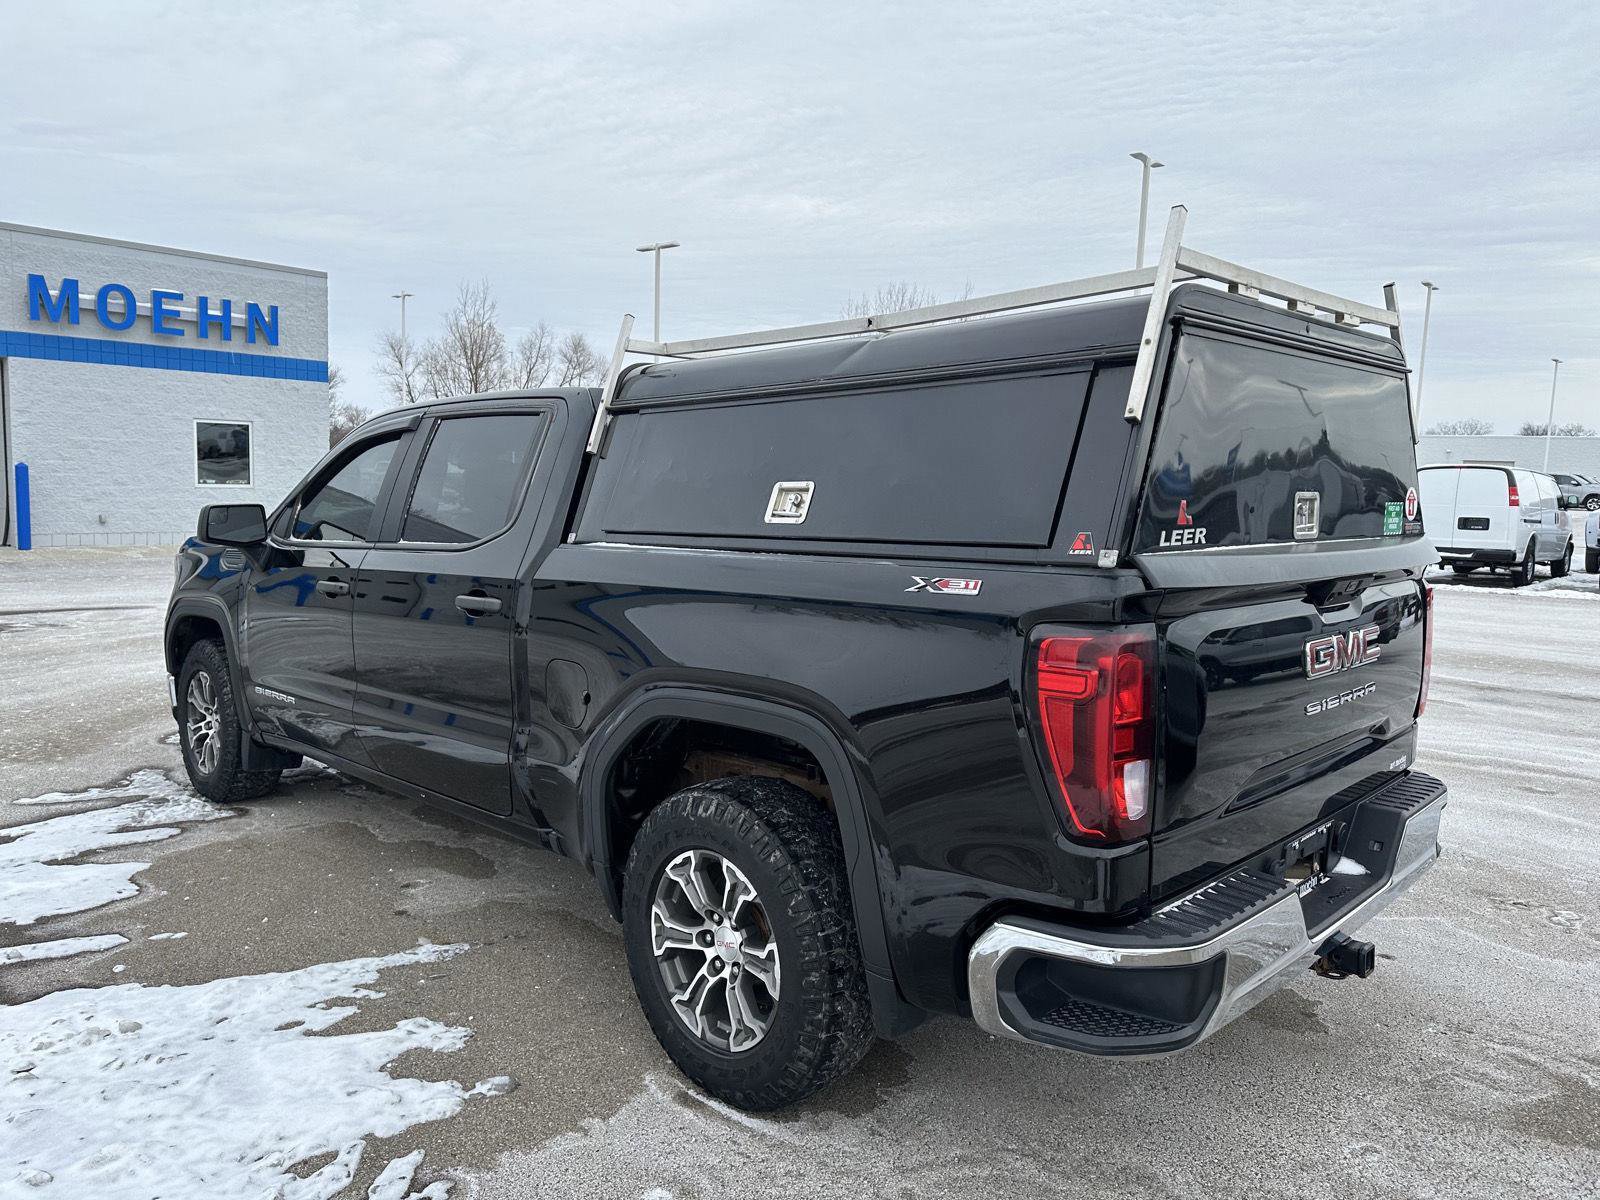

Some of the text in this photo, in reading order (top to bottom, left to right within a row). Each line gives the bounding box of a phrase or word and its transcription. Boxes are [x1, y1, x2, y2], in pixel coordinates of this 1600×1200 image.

[27, 273, 279, 346] MOEHN
[1159, 527, 1207, 546] LEER
[904, 576, 982, 595] X31
[1305, 625, 1380, 679] GMC
[254, 686, 296, 704] SIERRA
[1304, 681, 1376, 716] SIERRA
[716, 941, 735, 949] GMC
